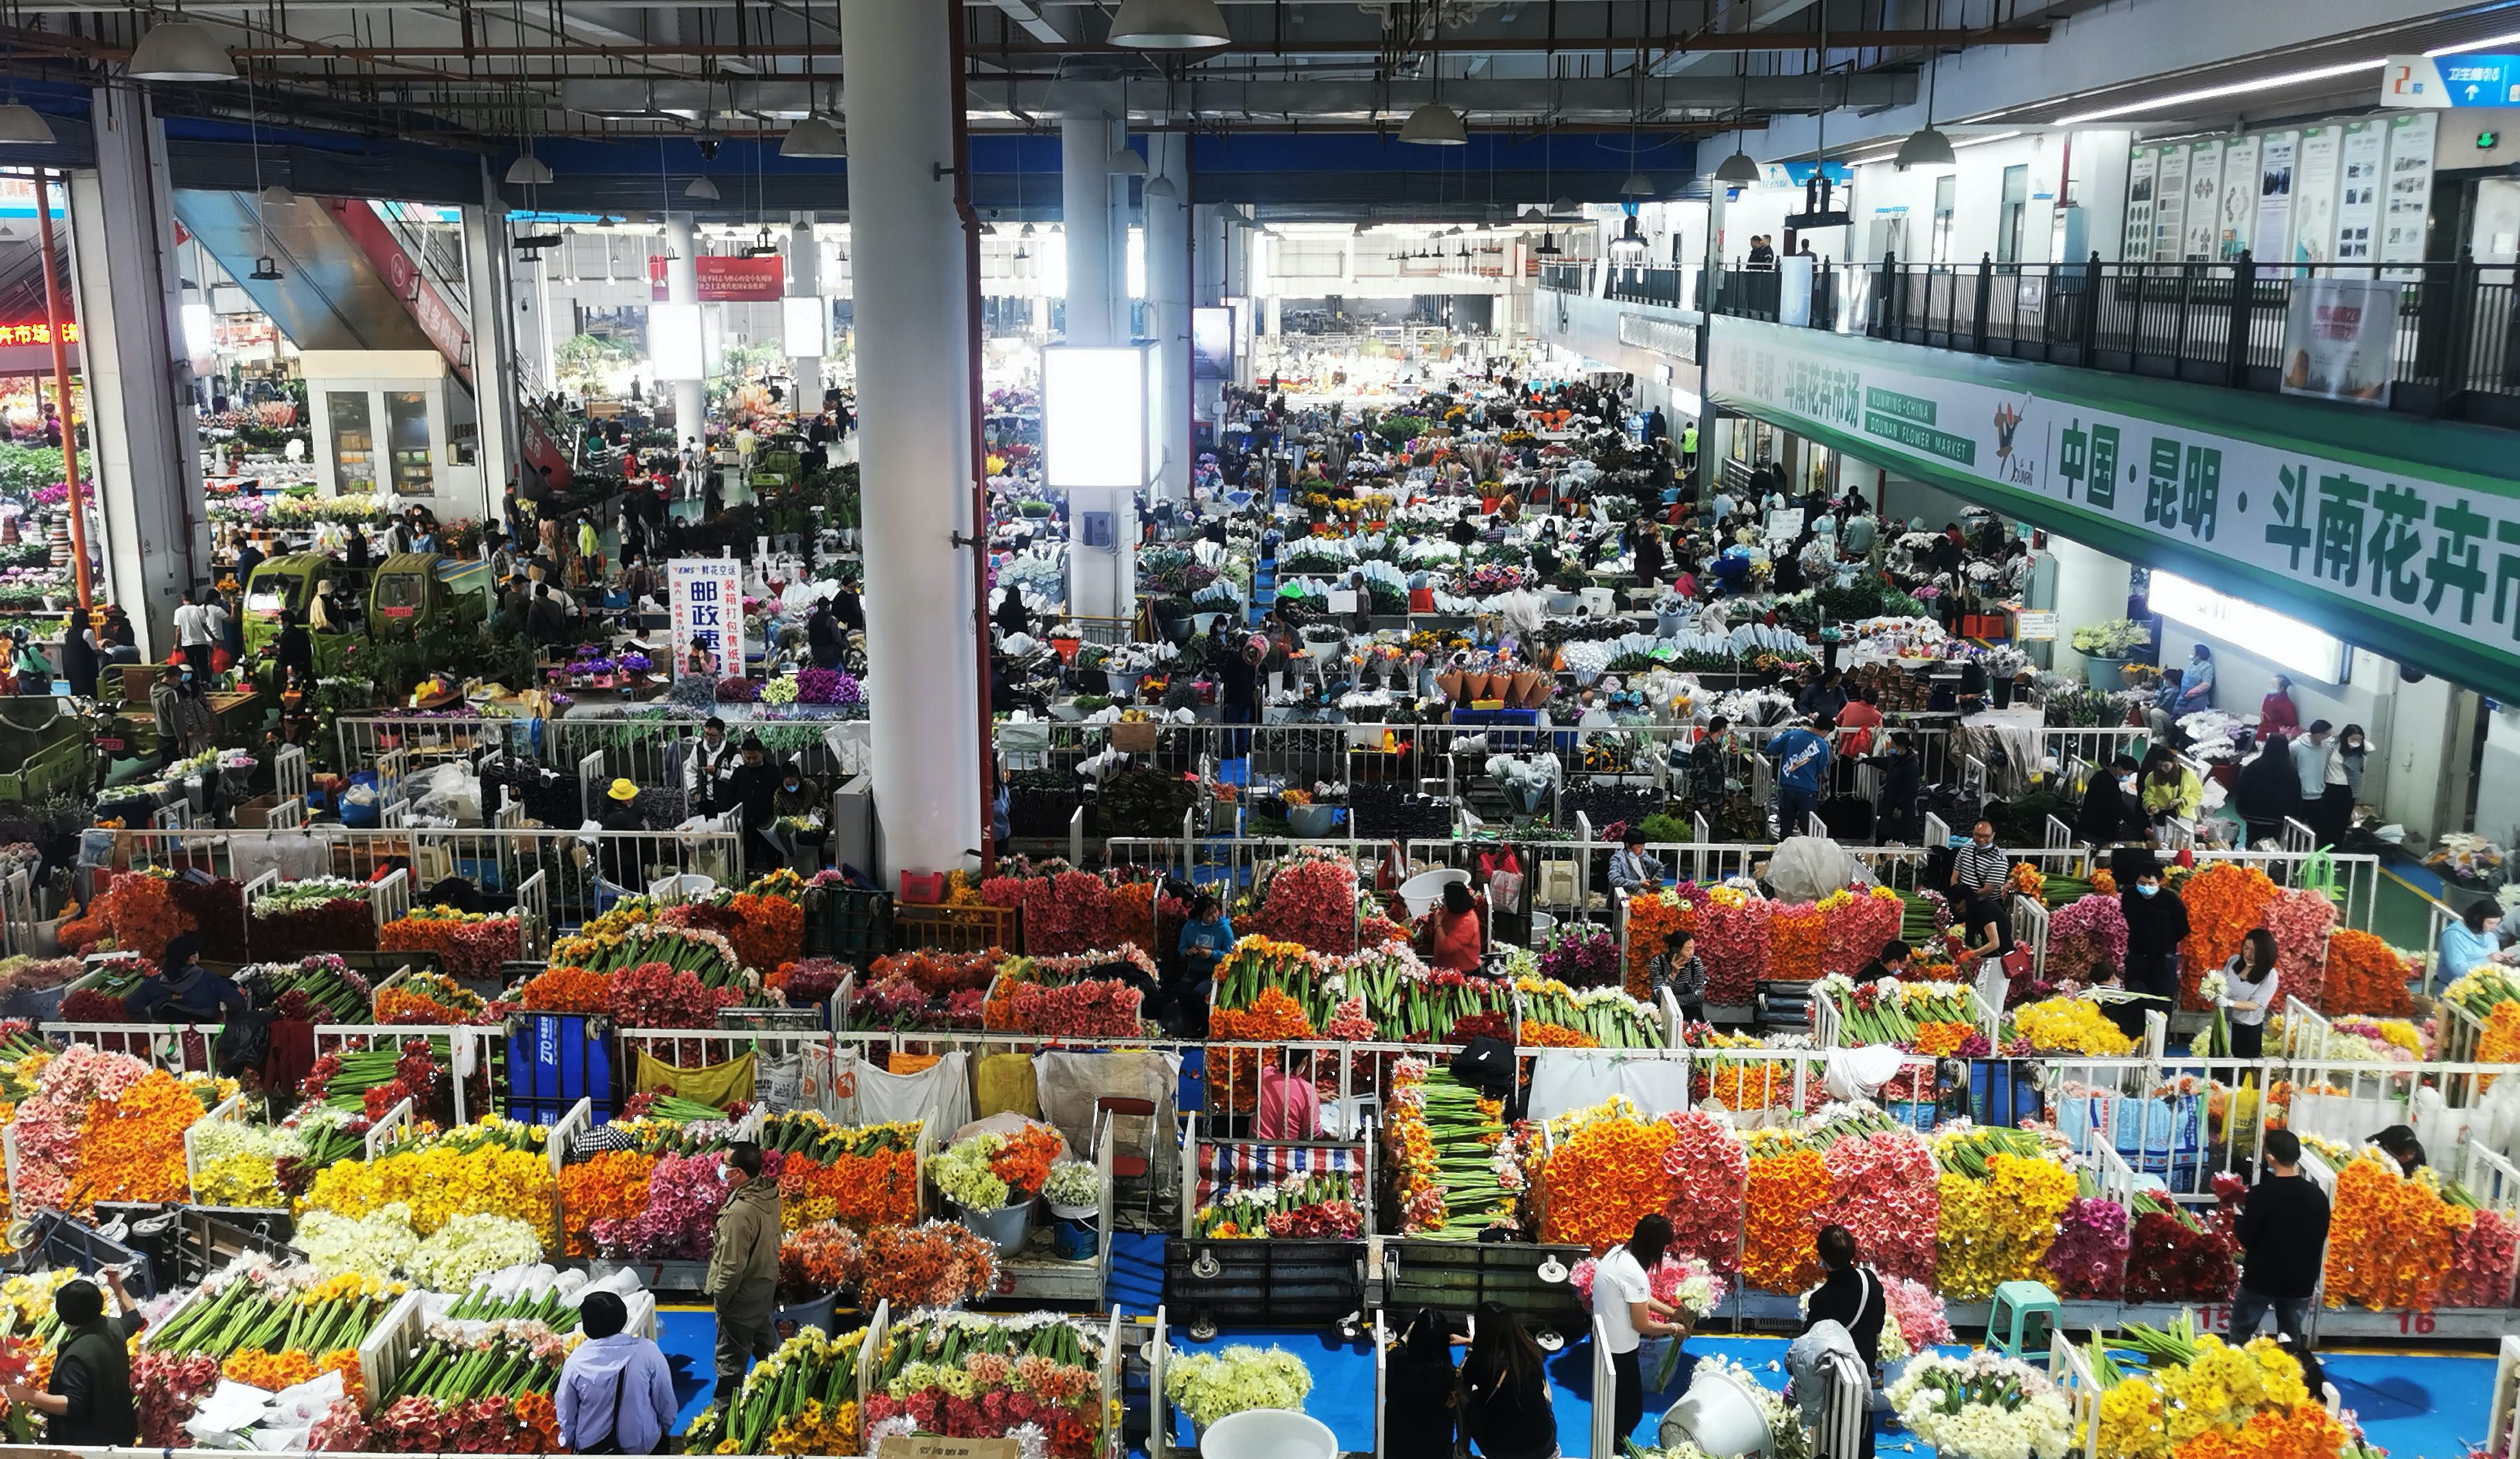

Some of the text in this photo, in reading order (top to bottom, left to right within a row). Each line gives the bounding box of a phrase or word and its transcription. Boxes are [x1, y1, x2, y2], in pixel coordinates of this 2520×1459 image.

[1870, 419, 1967, 461] DOUNAN FLOWER MARKET
[678, 566, 695, 575] EMS
[701, 565, 736, 576] 鲜花空运
[691, 581, 723, 675] 邮政速
[724, 579, 741, 675] 装箱打包售纸箱
[540, 1040, 553, 1065] ZTO
[651, 1261, 663, 1286] 7
[2394, 1310, 2436, 1335] 16
